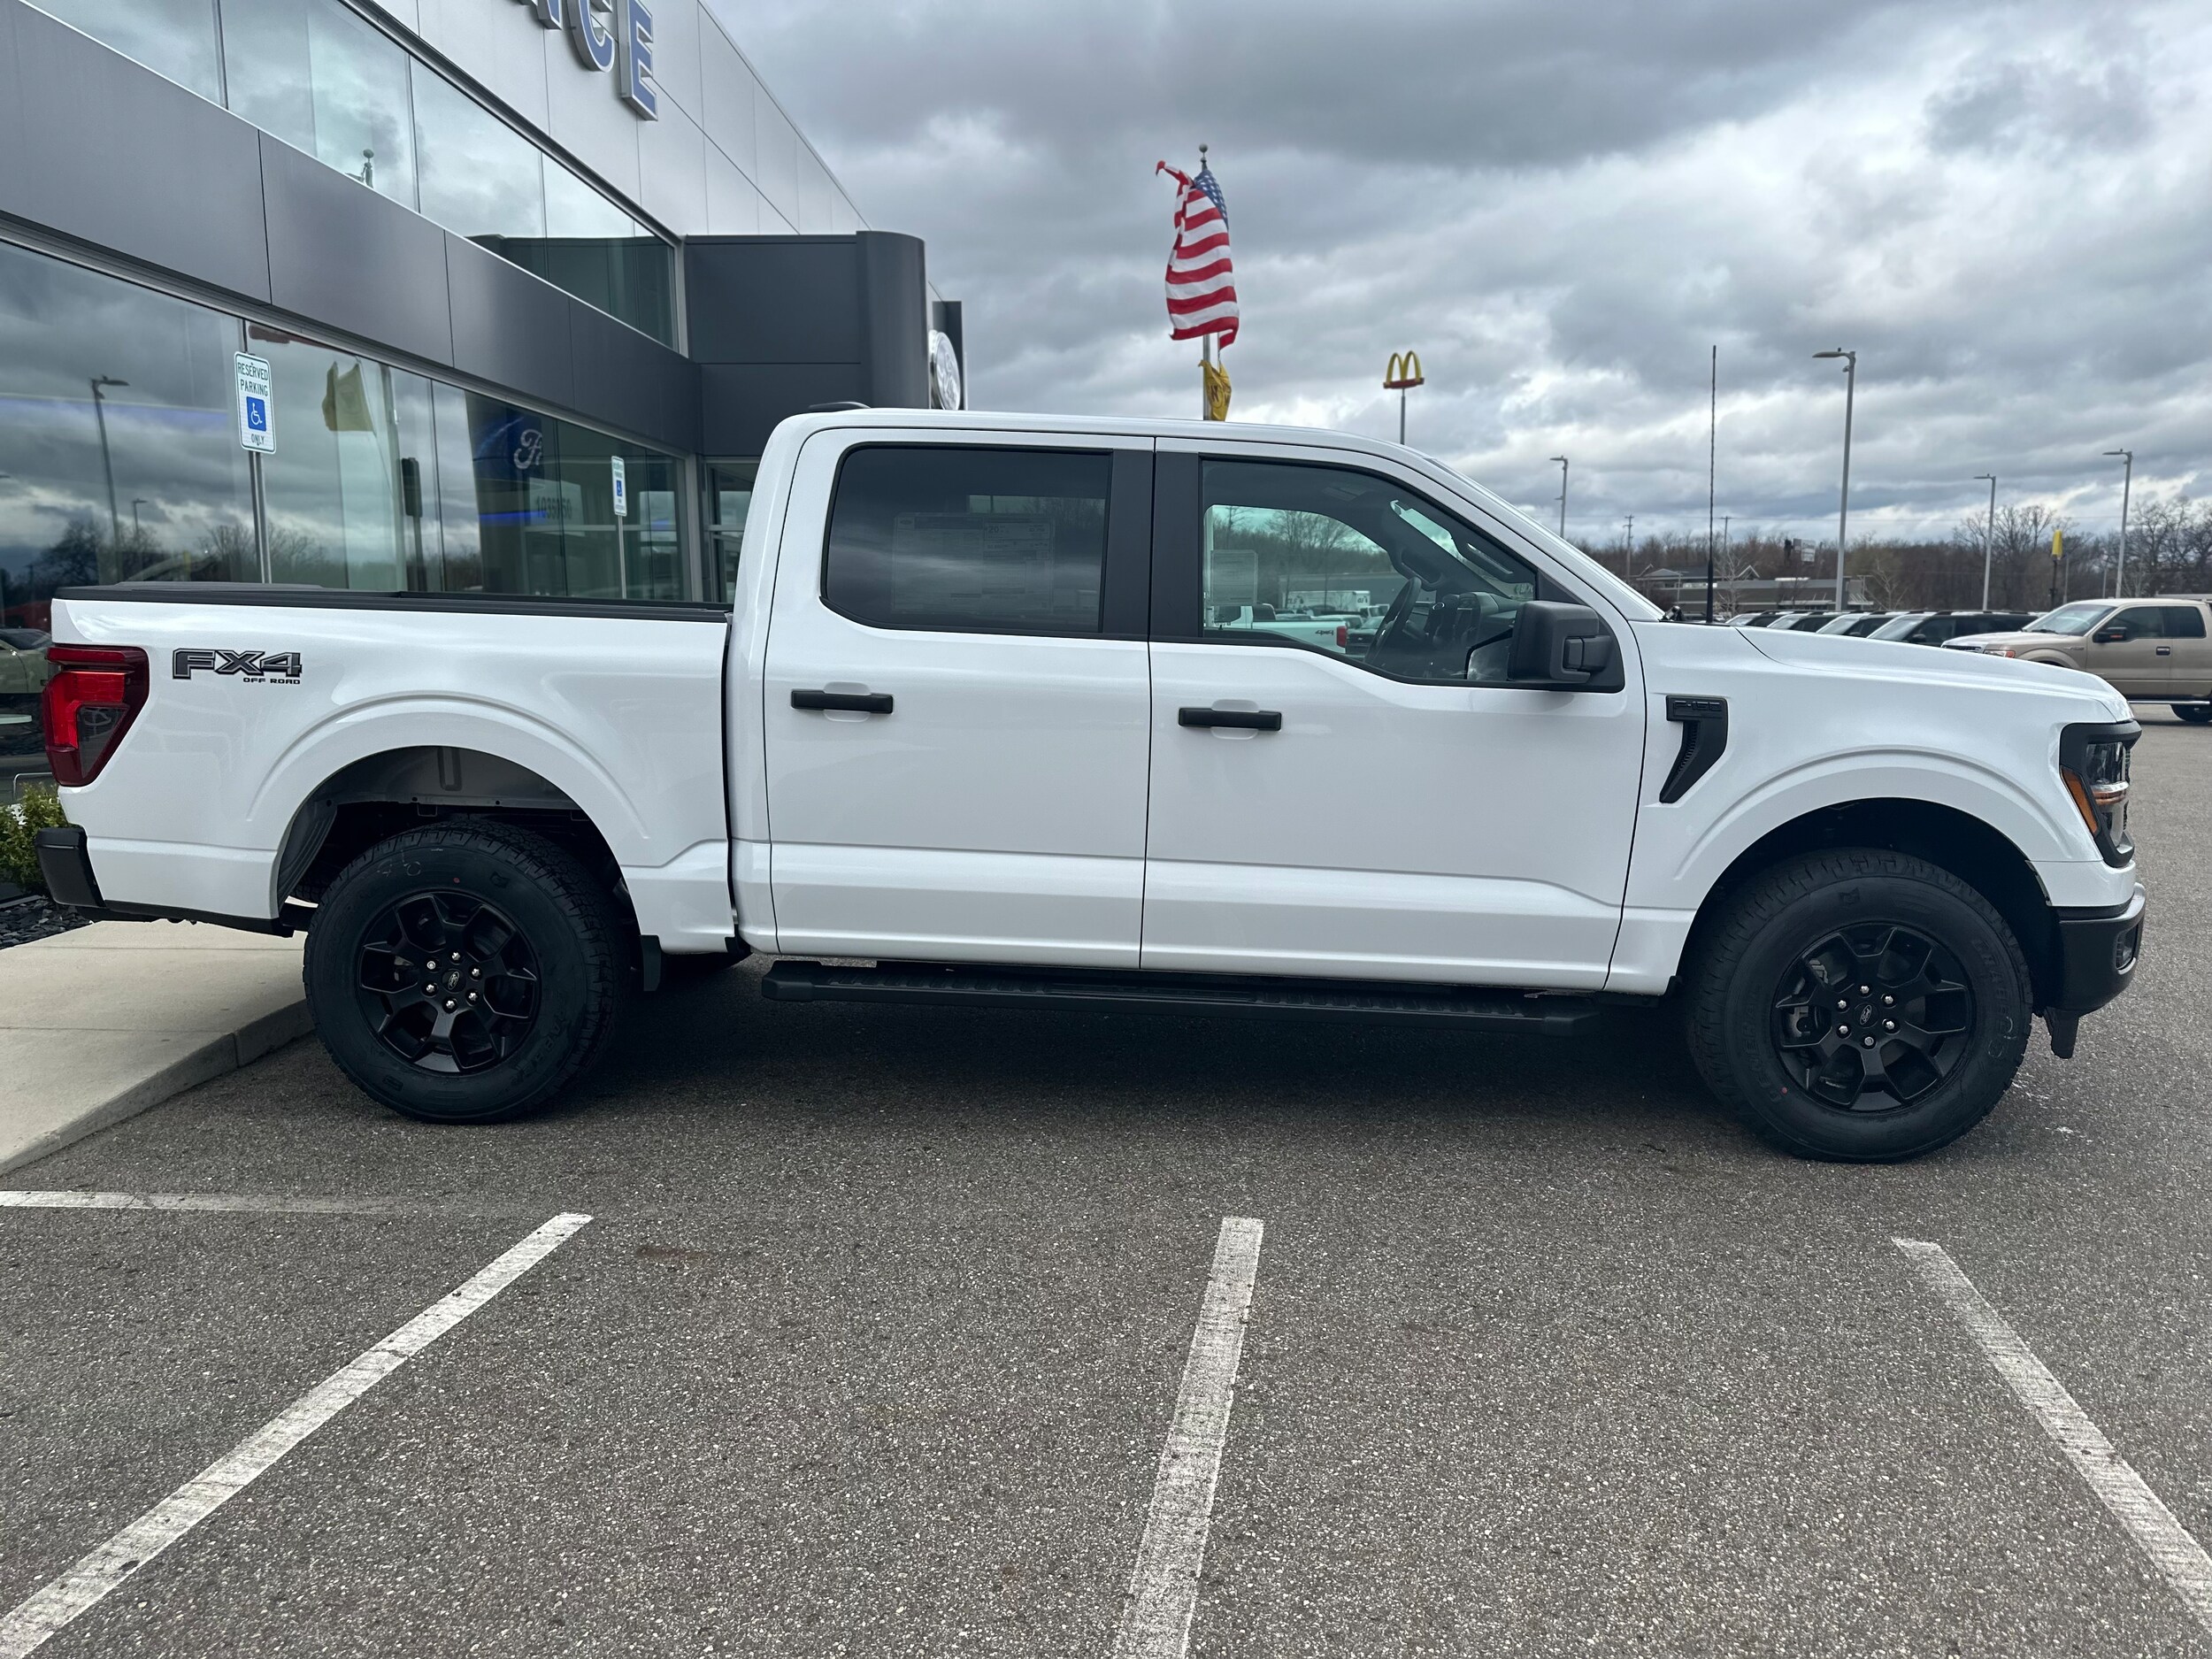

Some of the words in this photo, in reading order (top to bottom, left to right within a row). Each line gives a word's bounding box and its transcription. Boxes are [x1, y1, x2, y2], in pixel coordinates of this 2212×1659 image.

[237, 362, 269, 381] RESERVED
[240, 379, 269, 397] PARKING
[250, 434, 265, 445] ONLY
[173, 648, 303, 680] FX4
